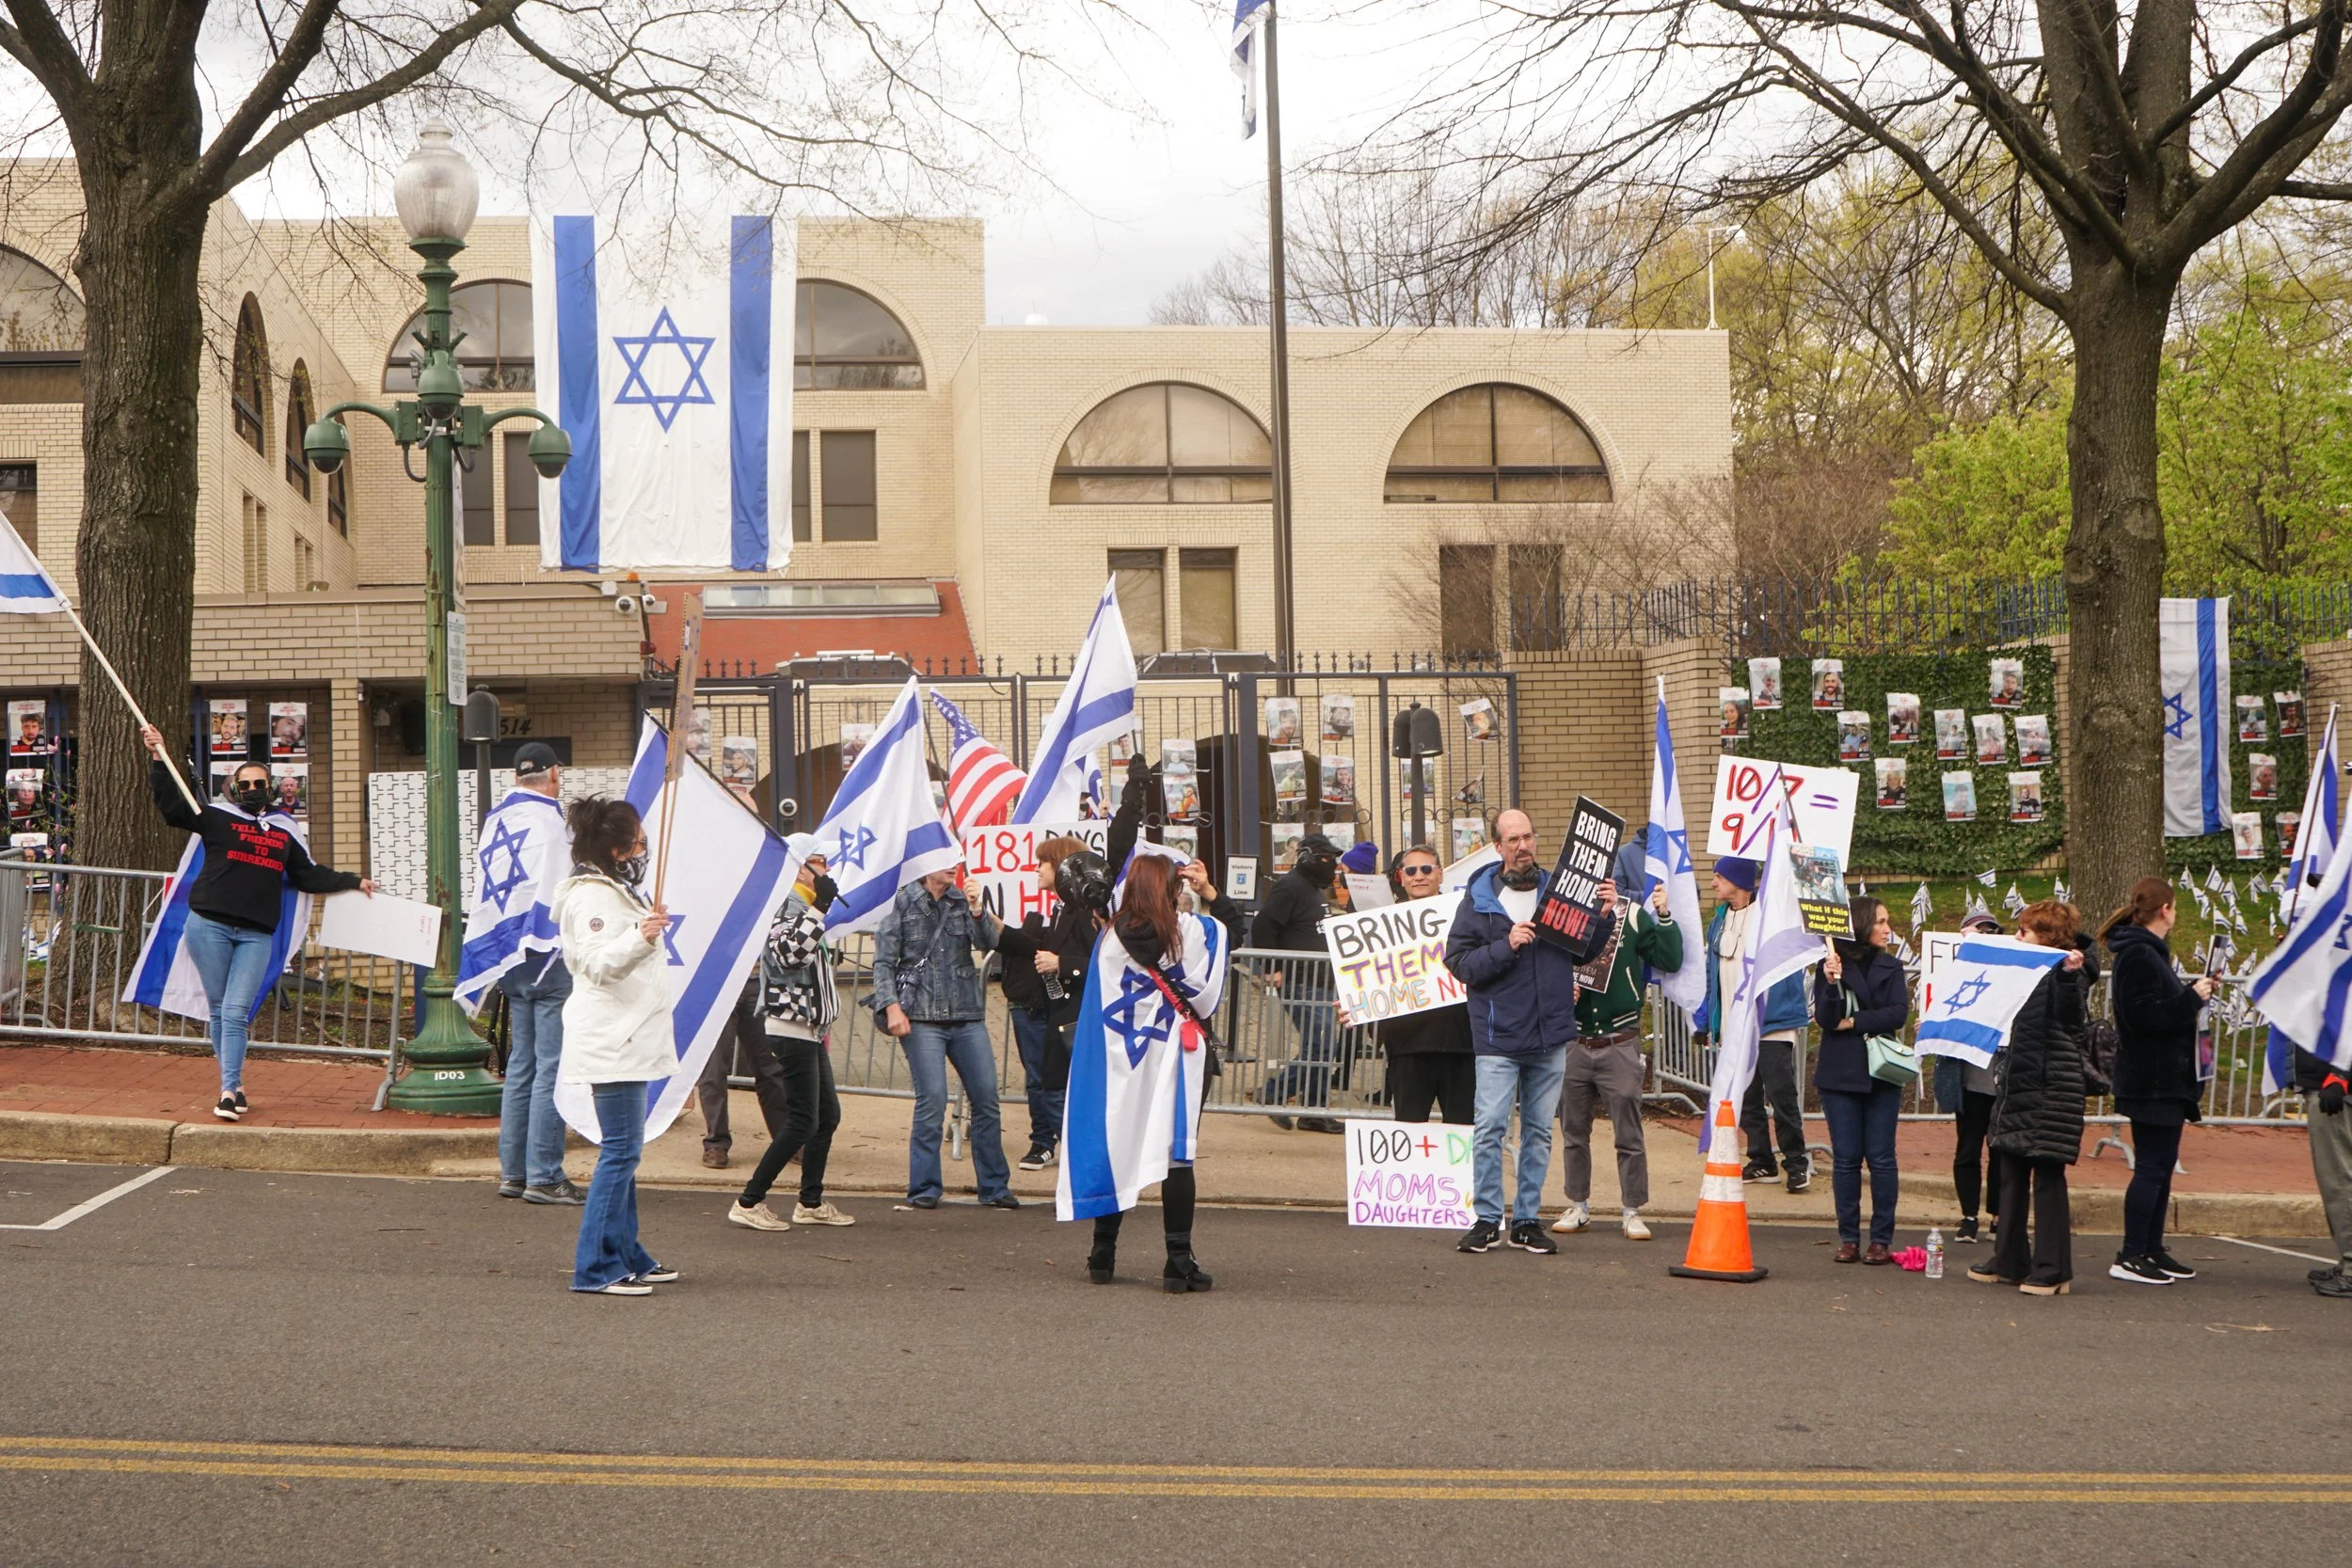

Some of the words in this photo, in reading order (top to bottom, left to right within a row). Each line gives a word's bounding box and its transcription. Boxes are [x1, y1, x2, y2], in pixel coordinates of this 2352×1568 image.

[1726, 764, 1805, 815] 10/7
[230, 822, 258, 833] TELL
[240, 832, 284, 849] FRIENDS
[1575, 810, 1617, 853] BRING
[255, 845, 268, 856] TO
[971, 830, 1039, 874] 181
[1568, 840, 1609, 880] THEM
[1555, 869, 1600, 909] HOME
[1540, 896, 1590, 941] NOW!
[1800, 903, 1823, 913] What
[1832, 907, 1850, 916] this
[1808, 913, 1825, 922] was
[1827, 915, 1845, 925] your
[1808, 921, 1850, 933] daughter?
[1332, 908, 1448, 958] BRING
[1341, 941, 1446, 989] THEM
[1579, 974, 1596, 985] NOW
[1346, 979, 1431, 1022] HOME
[434, 1070, 466, 1081] ID03
[1354, 1169, 1461, 1207] MOMS
[1356, 1201, 1470, 1227] DAUGHTERS
